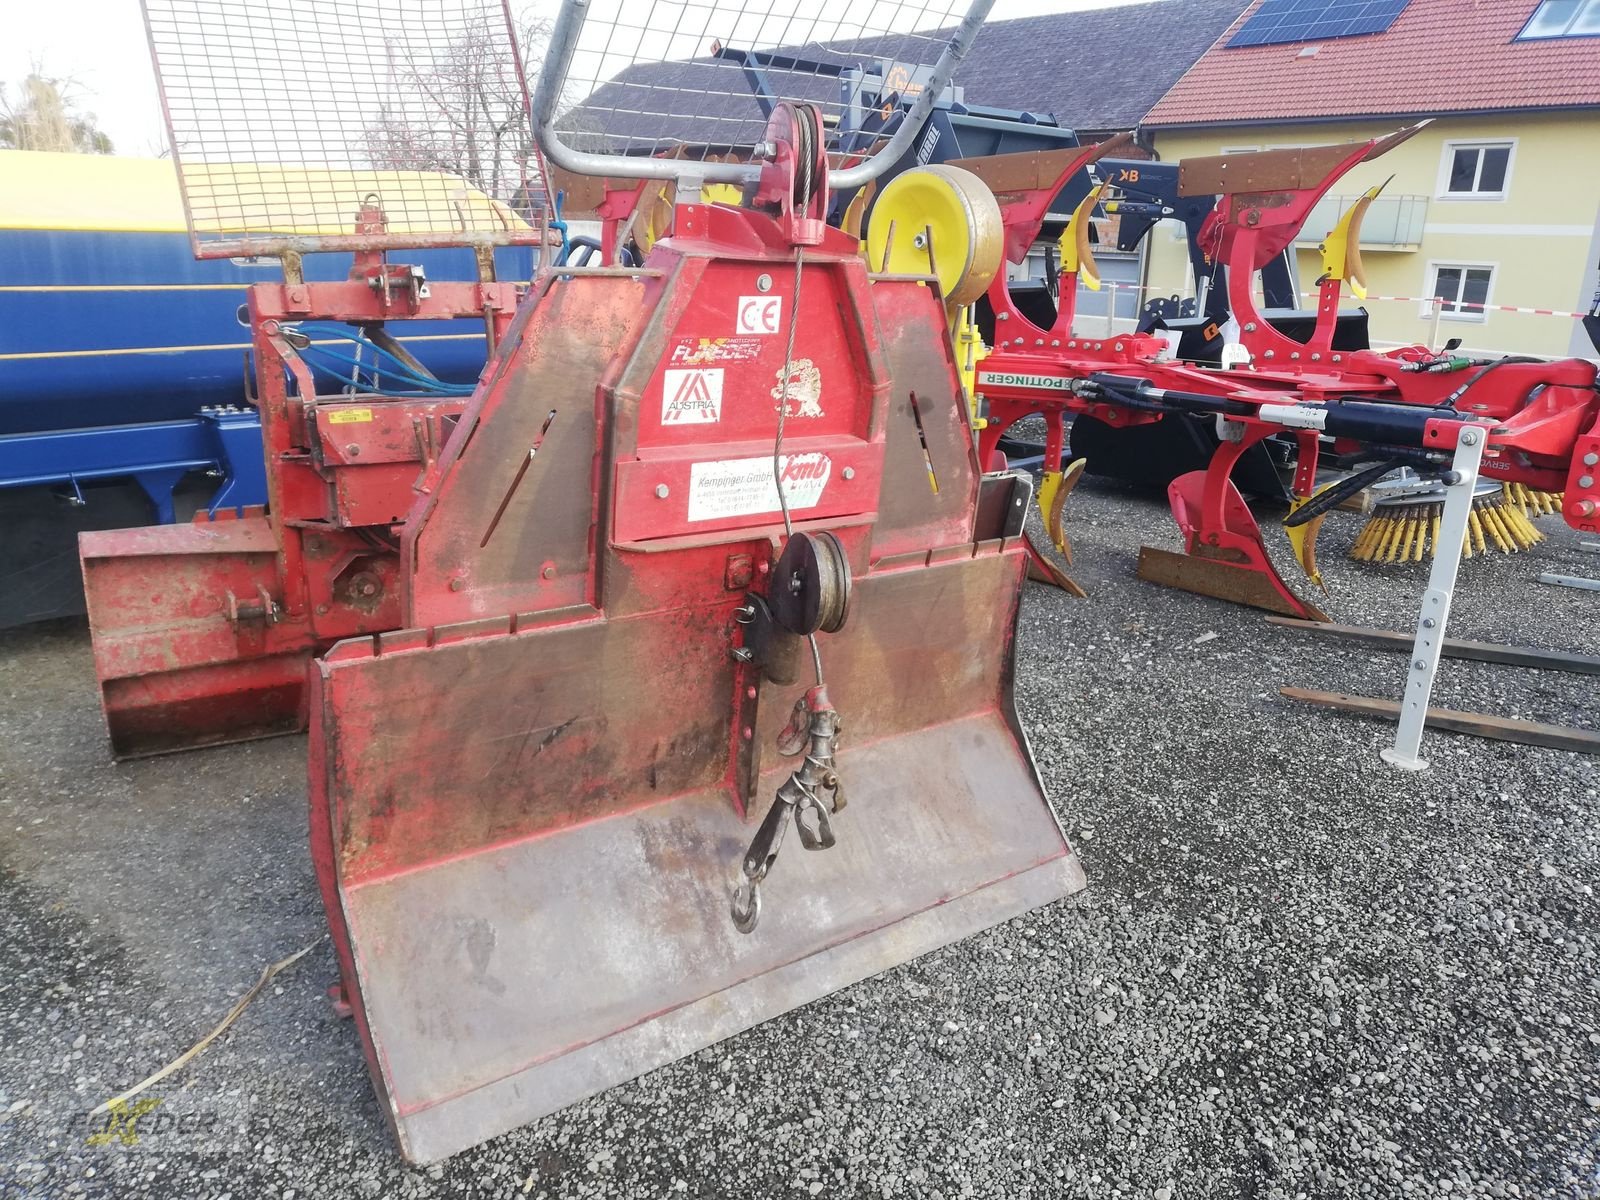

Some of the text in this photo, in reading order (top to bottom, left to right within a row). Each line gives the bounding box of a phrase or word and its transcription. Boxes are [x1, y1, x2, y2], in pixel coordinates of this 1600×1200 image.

[1118, 168, 1139, 182] XB
[741, 300, 777, 331] CE
[668, 400, 715, 410] AUSTRIA
[780, 455, 827, 482] kmb
[698, 472, 773, 488] Kempinger GmbH
